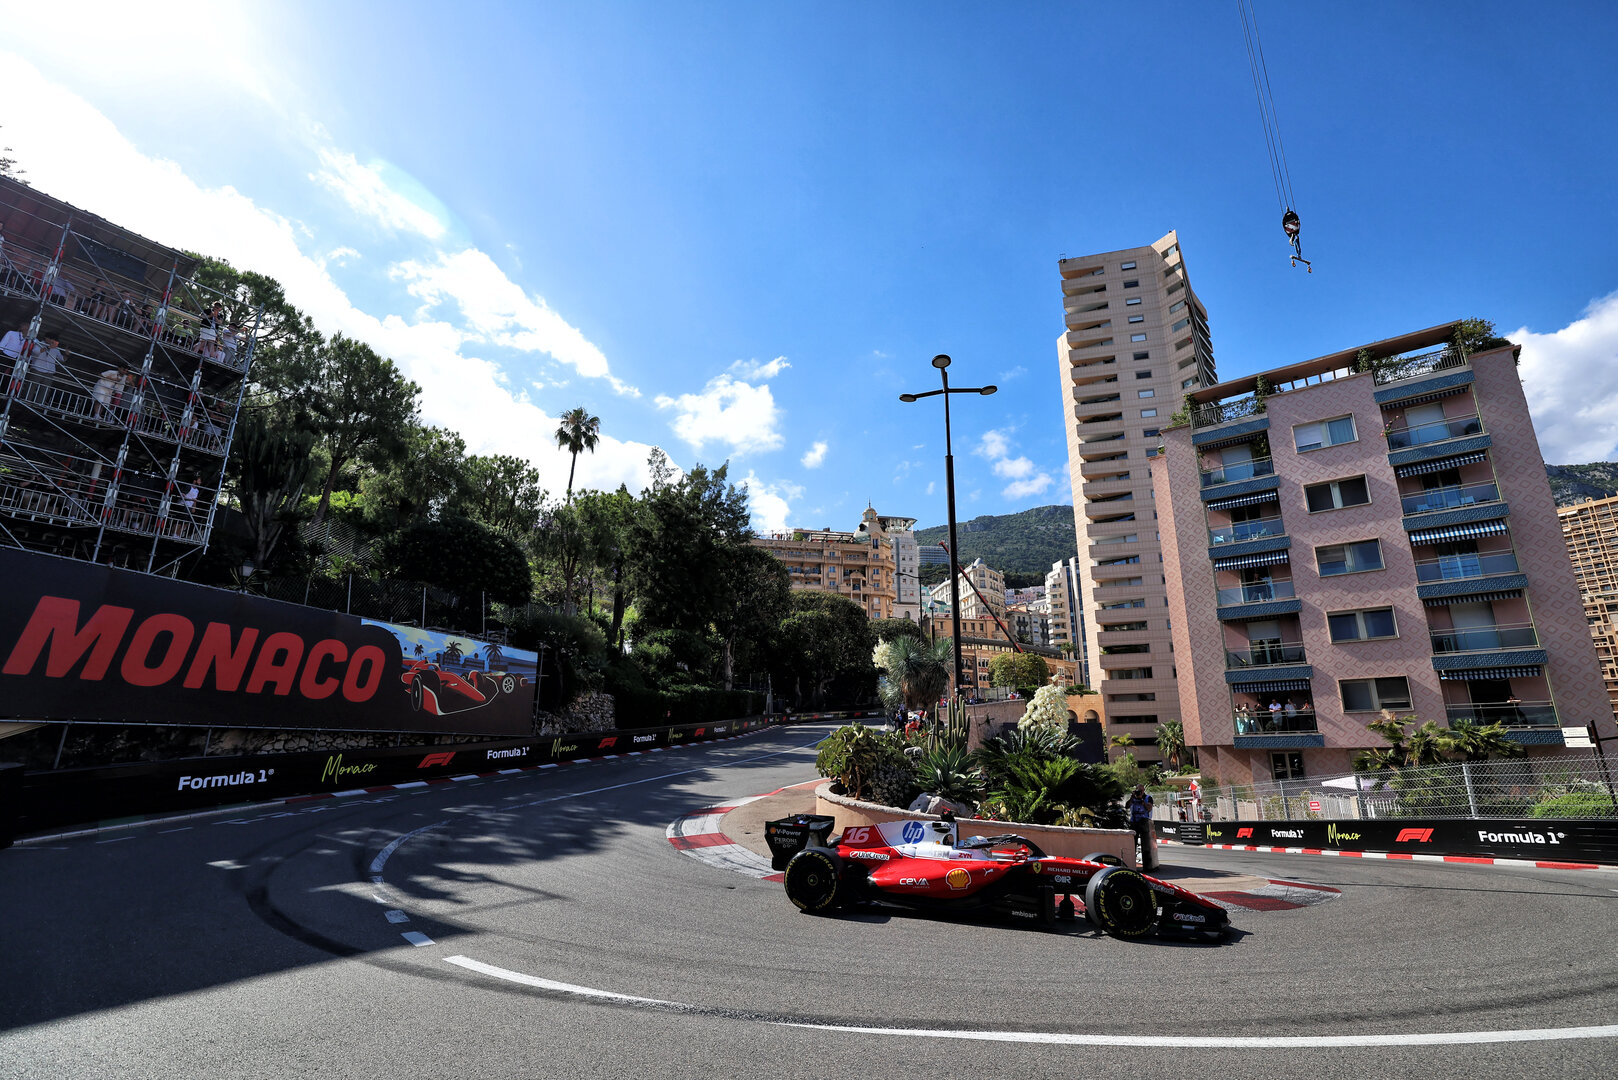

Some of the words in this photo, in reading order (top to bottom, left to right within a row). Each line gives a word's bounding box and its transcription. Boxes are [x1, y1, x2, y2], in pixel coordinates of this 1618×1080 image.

[2, 595, 386, 702] MONACO
[598, 737, 618, 748] F1
[633, 735, 652, 743] Formula
[487, 748, 521, 759] Formula
[551, 737, 578, 758] Monaco
[417, 752, 456, 768] F1
[321, 753, 378, 784] Monaco
[178, 771, 254, 791] Formula
[844, 827, 870, 844] 16
[905, 821, 922, 844] hp
[1236, 827, 1254, 838] F1
[1271, 829, 1297, 838] Formula
[1328, 823, 1361, 846] Monaco
[1395, 828, 1434, 842] F1
[1478, 831, 1545, 844] Formula
